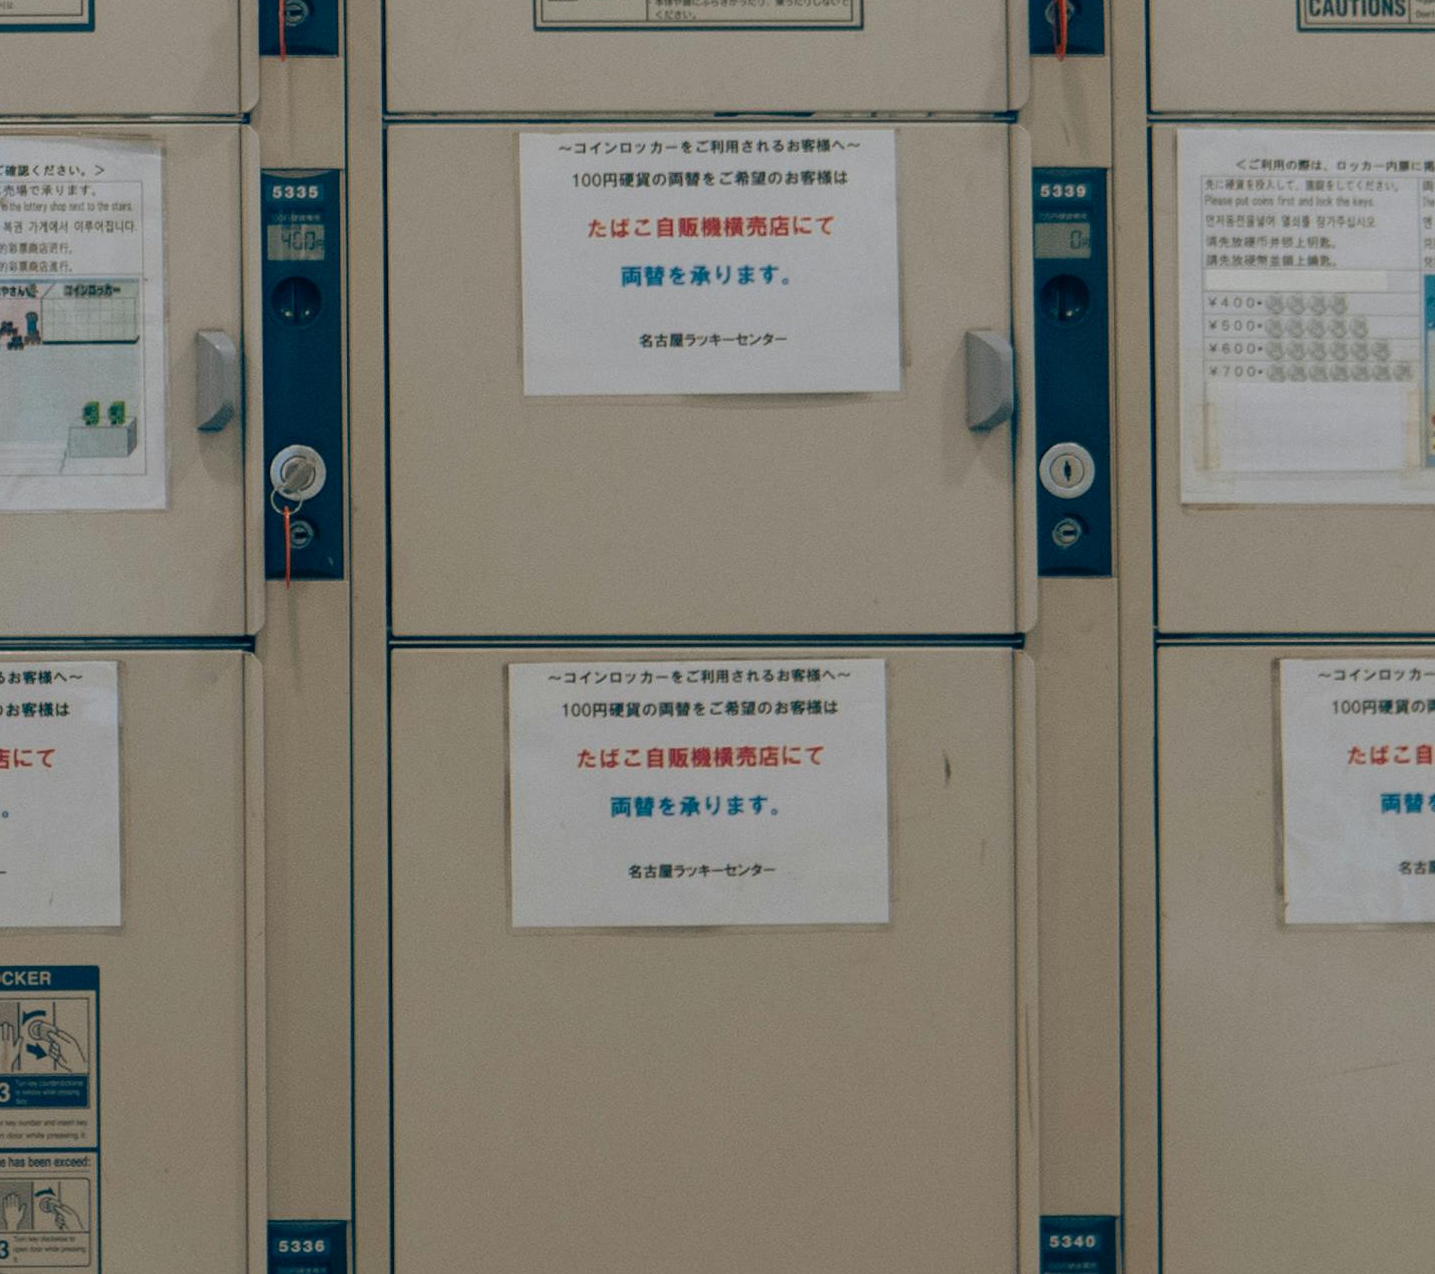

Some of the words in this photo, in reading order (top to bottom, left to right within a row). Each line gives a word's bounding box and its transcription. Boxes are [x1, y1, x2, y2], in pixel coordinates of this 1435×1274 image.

[273, 186, 318, 198] 5335
[1041, 185, 1085, 198] 5339
[588, 214, 835, 239] たばこ自販機横売店にて
[619, 263, 790, 289] 両替を承ります。
[609, 793, 779, 819] 両替を承ります。
[279, 1240, 324, 1252] 5336
